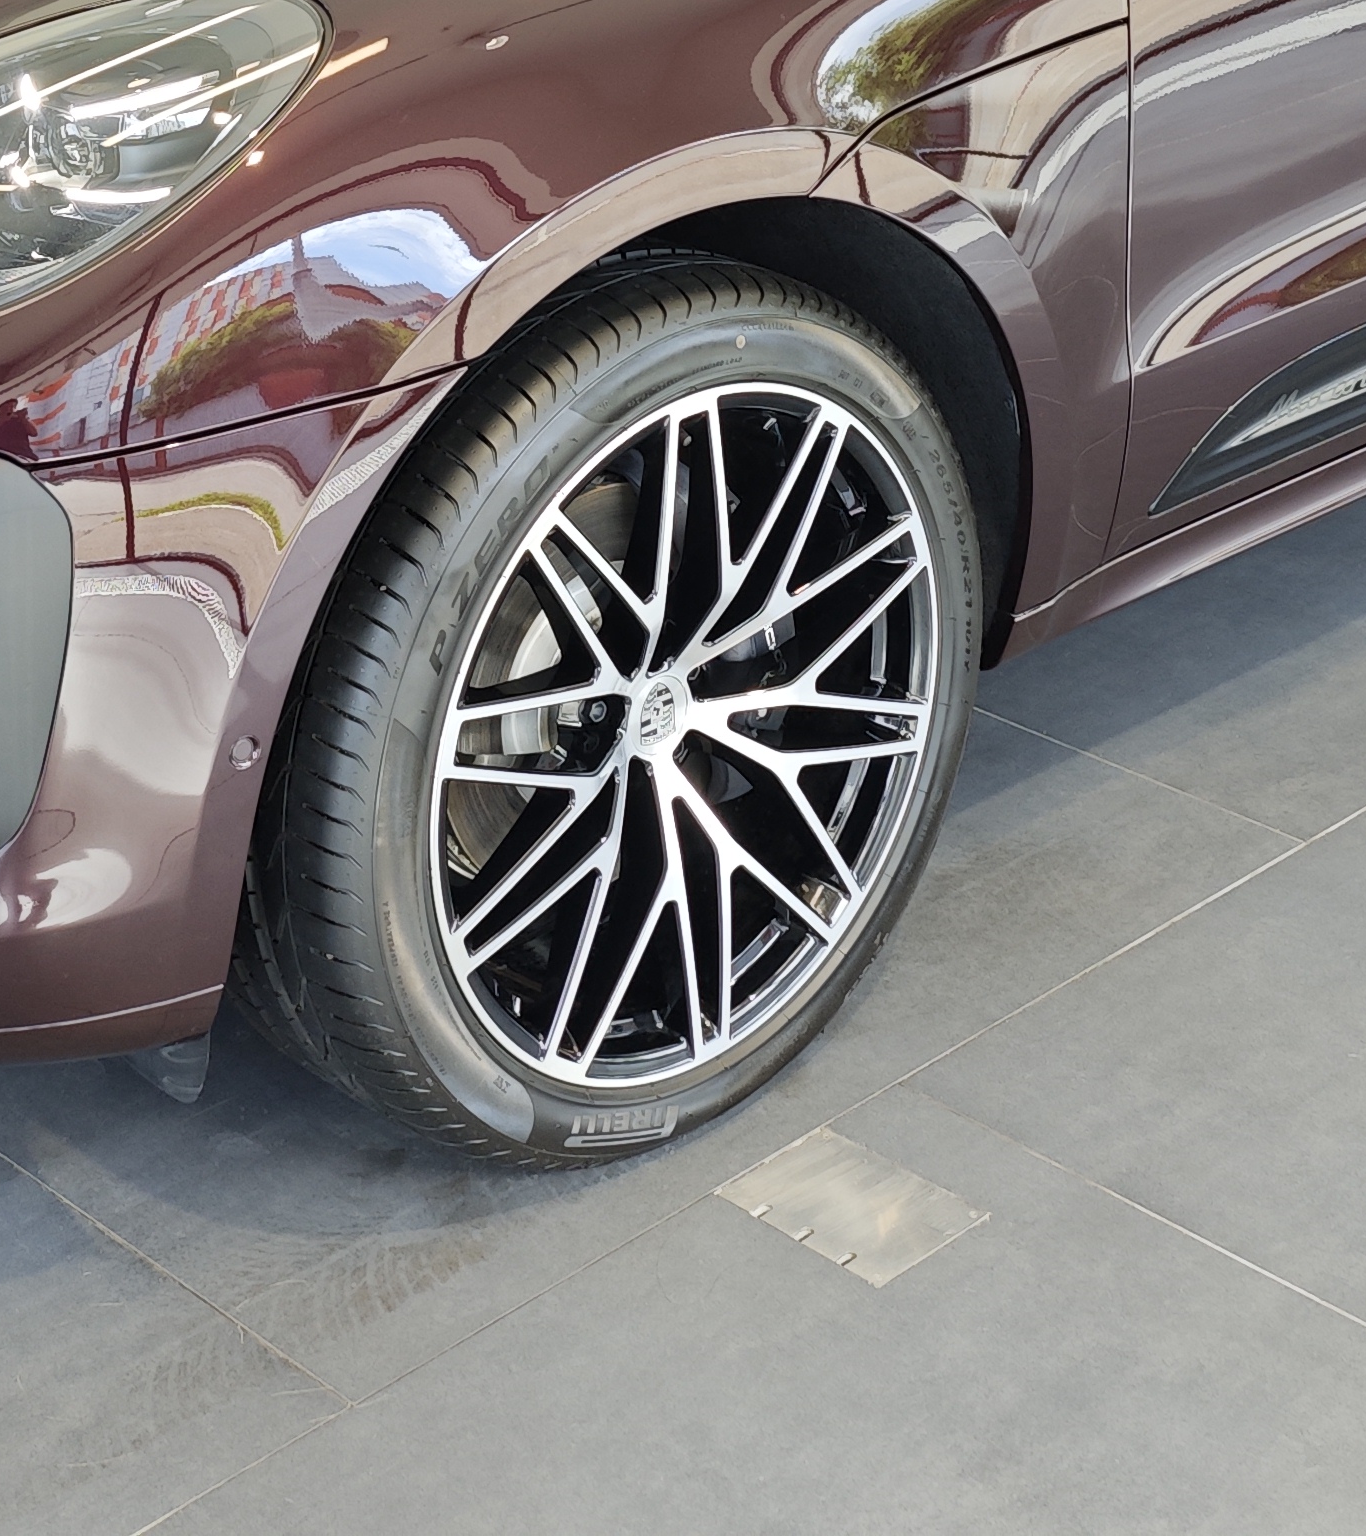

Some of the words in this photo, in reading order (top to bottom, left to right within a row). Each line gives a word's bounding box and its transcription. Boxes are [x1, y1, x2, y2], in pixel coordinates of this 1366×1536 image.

[424, 629, 449, 676] P
[451, 454, 551, 622] ZERO
[563, 1105, 679, 1148] PIRELLI
